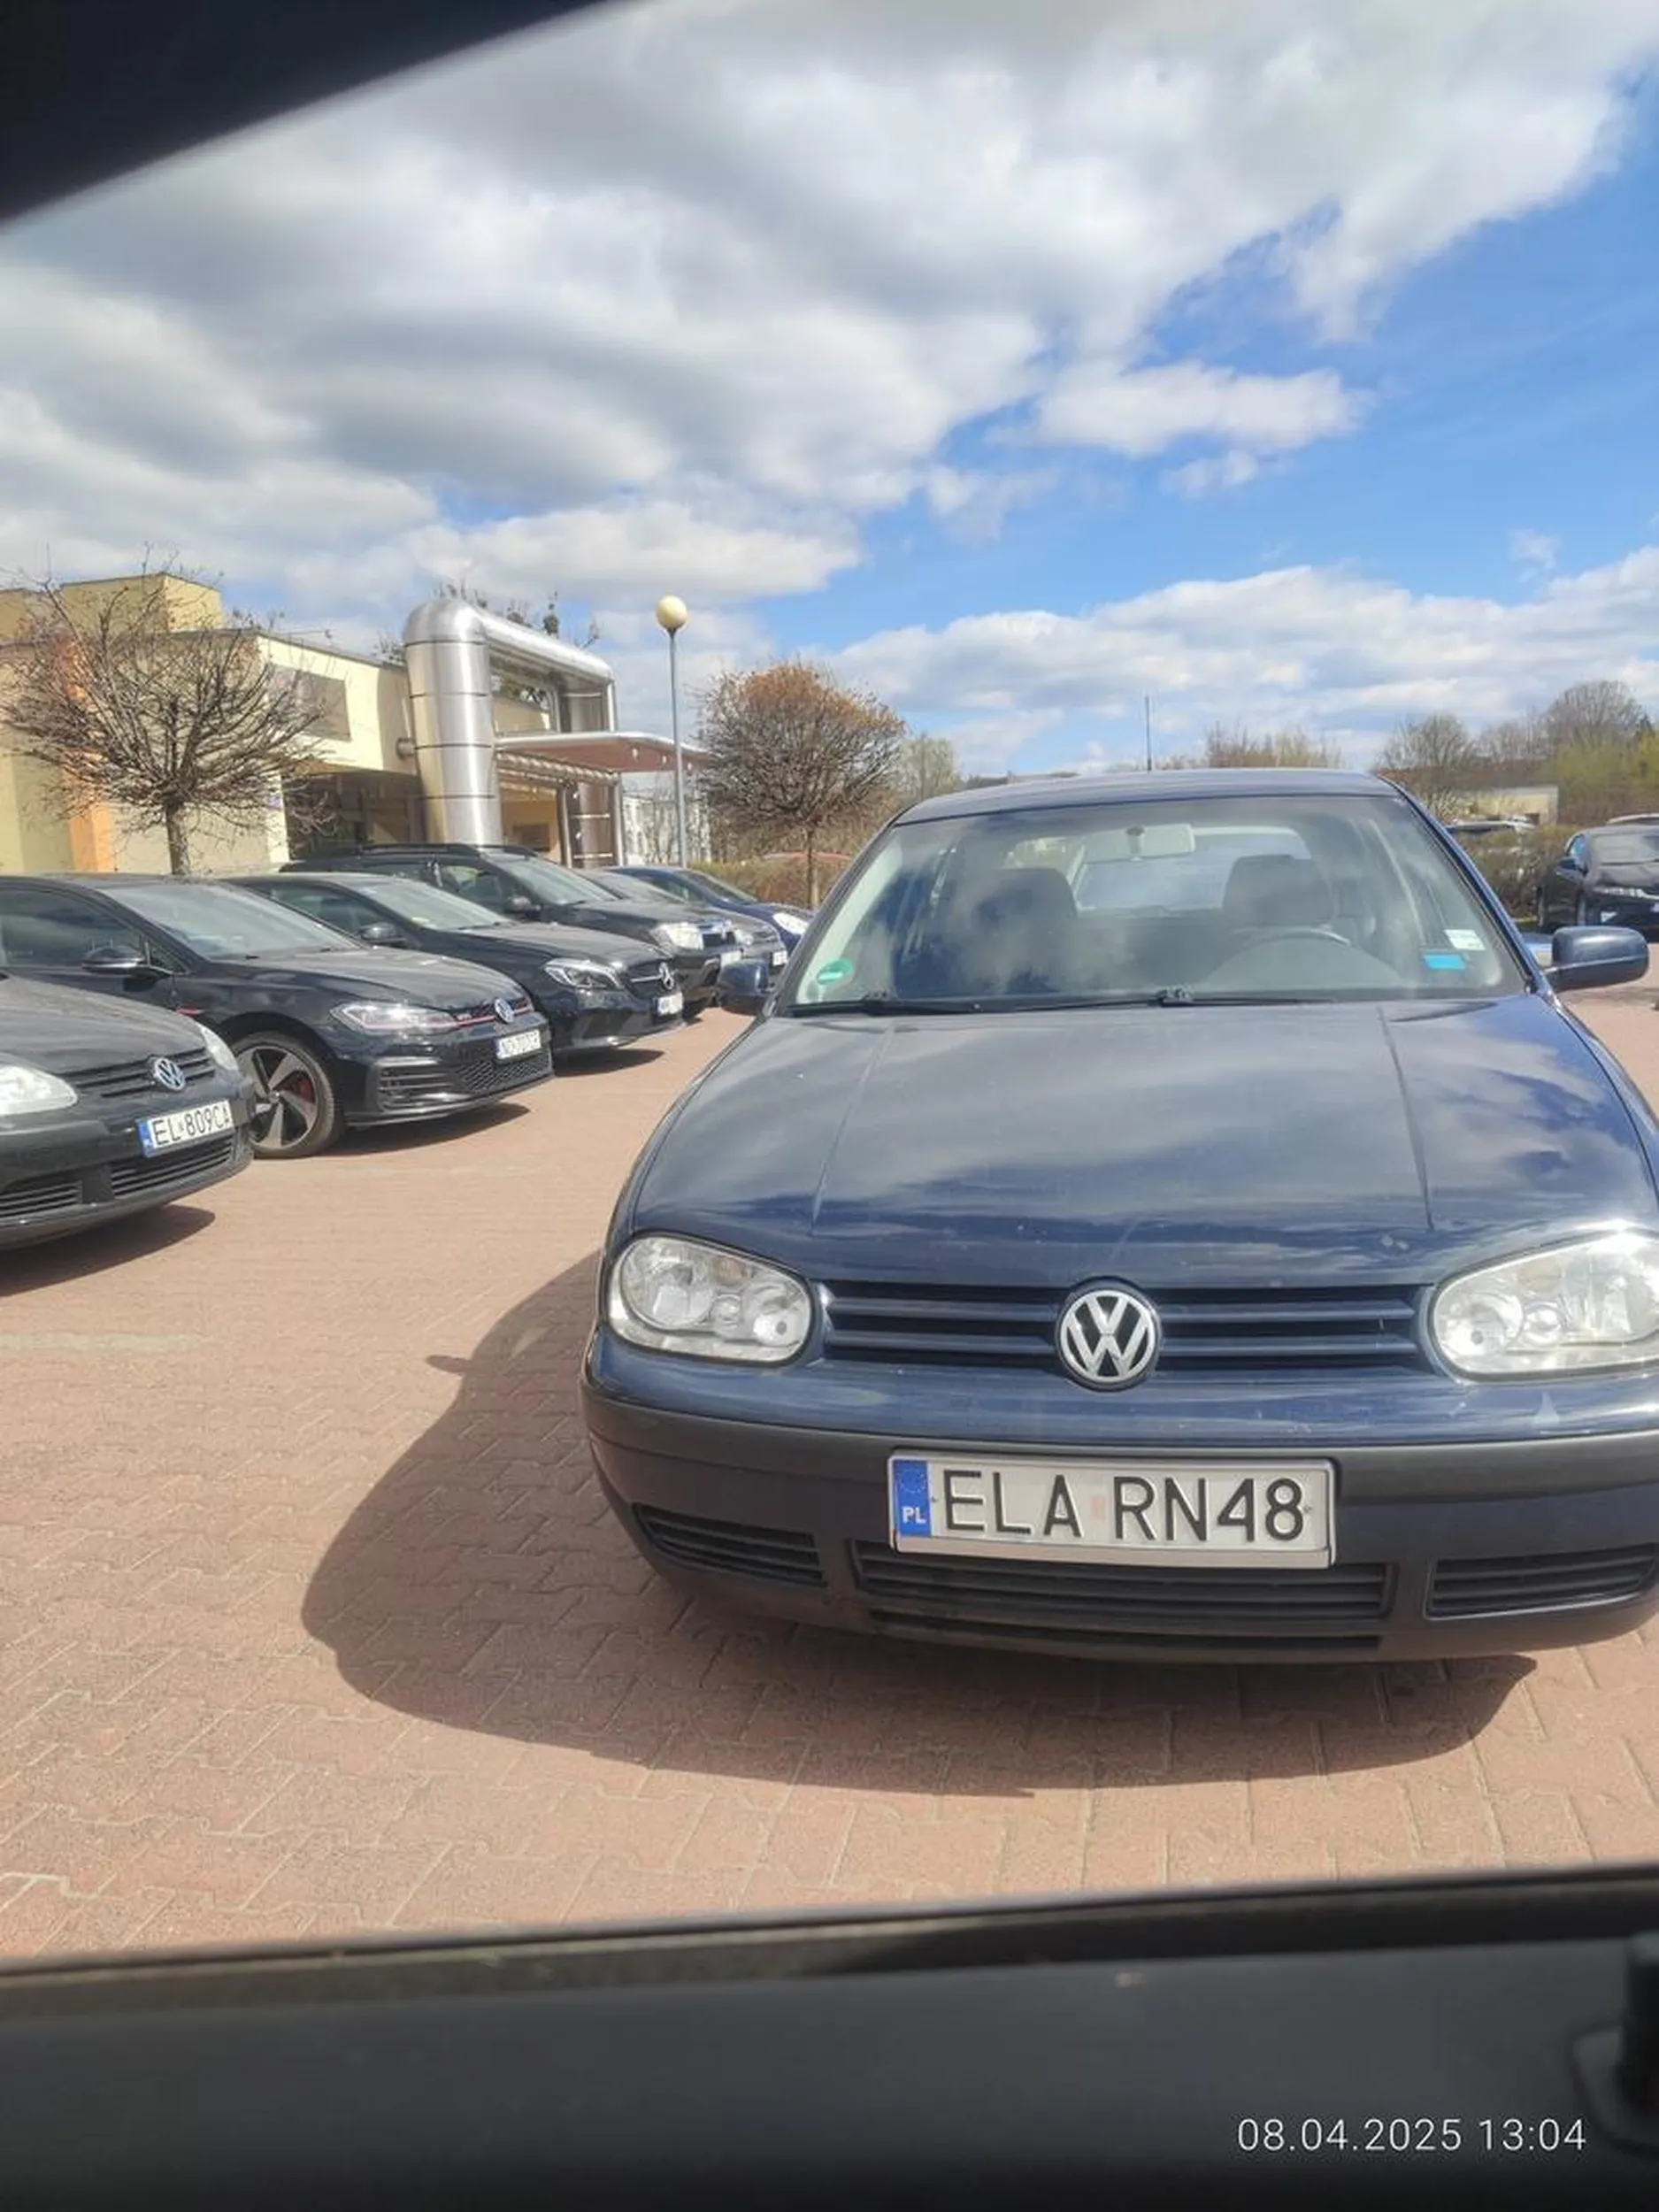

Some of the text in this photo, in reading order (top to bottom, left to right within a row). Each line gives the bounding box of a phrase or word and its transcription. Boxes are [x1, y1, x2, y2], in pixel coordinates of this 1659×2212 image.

[154, 1057, 185, 1090] VW
[151, 1118, 181, 1145] EL
[1061, 1289, 1156, 1383] VW
[902, 1507, 926, 1524] PL
[943, 1469, 1304, 1542] ELA RN48
